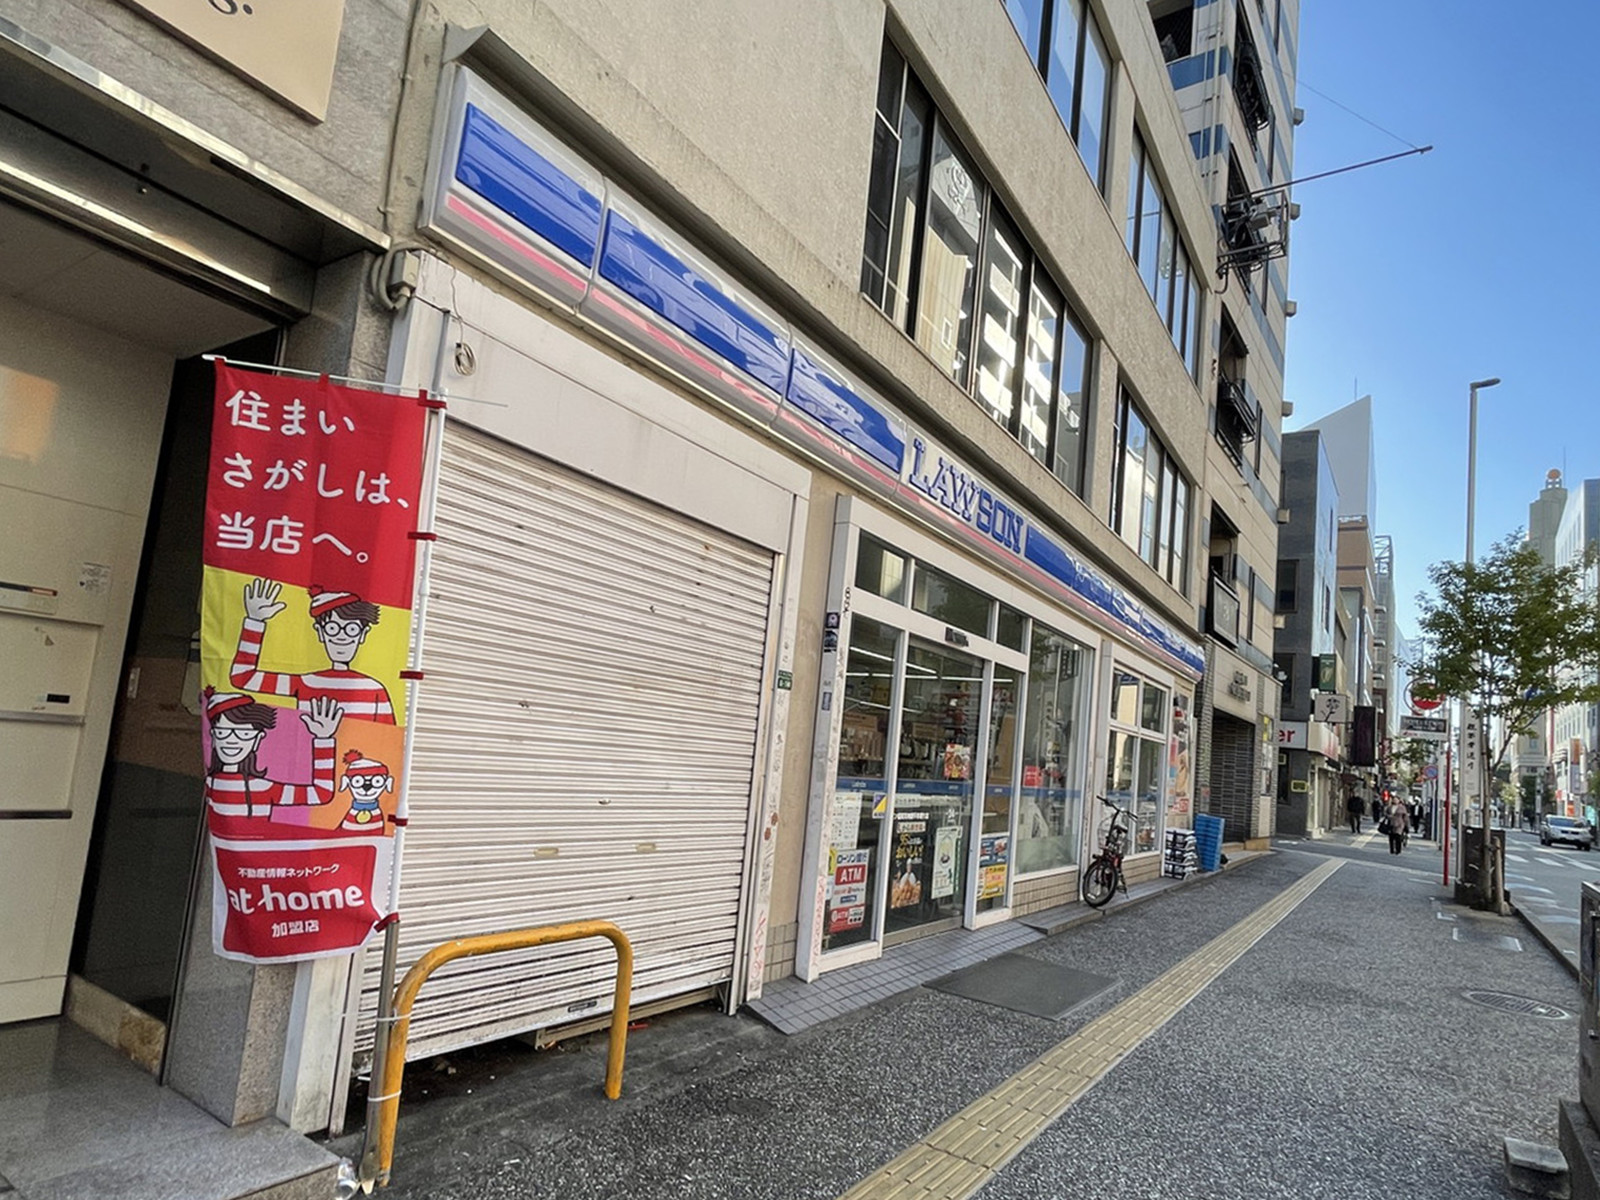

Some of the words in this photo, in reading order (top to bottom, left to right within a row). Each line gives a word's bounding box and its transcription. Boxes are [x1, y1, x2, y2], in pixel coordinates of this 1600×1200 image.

[225, 389, 356, 435] 住まい
[222, 452, 409, 509] さがしは、
[908, 436, 1024, 554] LAWSON
[216, 511, 369, 564] 当店へ。
[237, 863, 340, 879] 不動産情報ネットワーク
[840, 867, 863, 882] ATM
[227, 888, 255, 915] at
[257, 884, 365, 912] home
[271, 920, 320, 938] 加盟店
